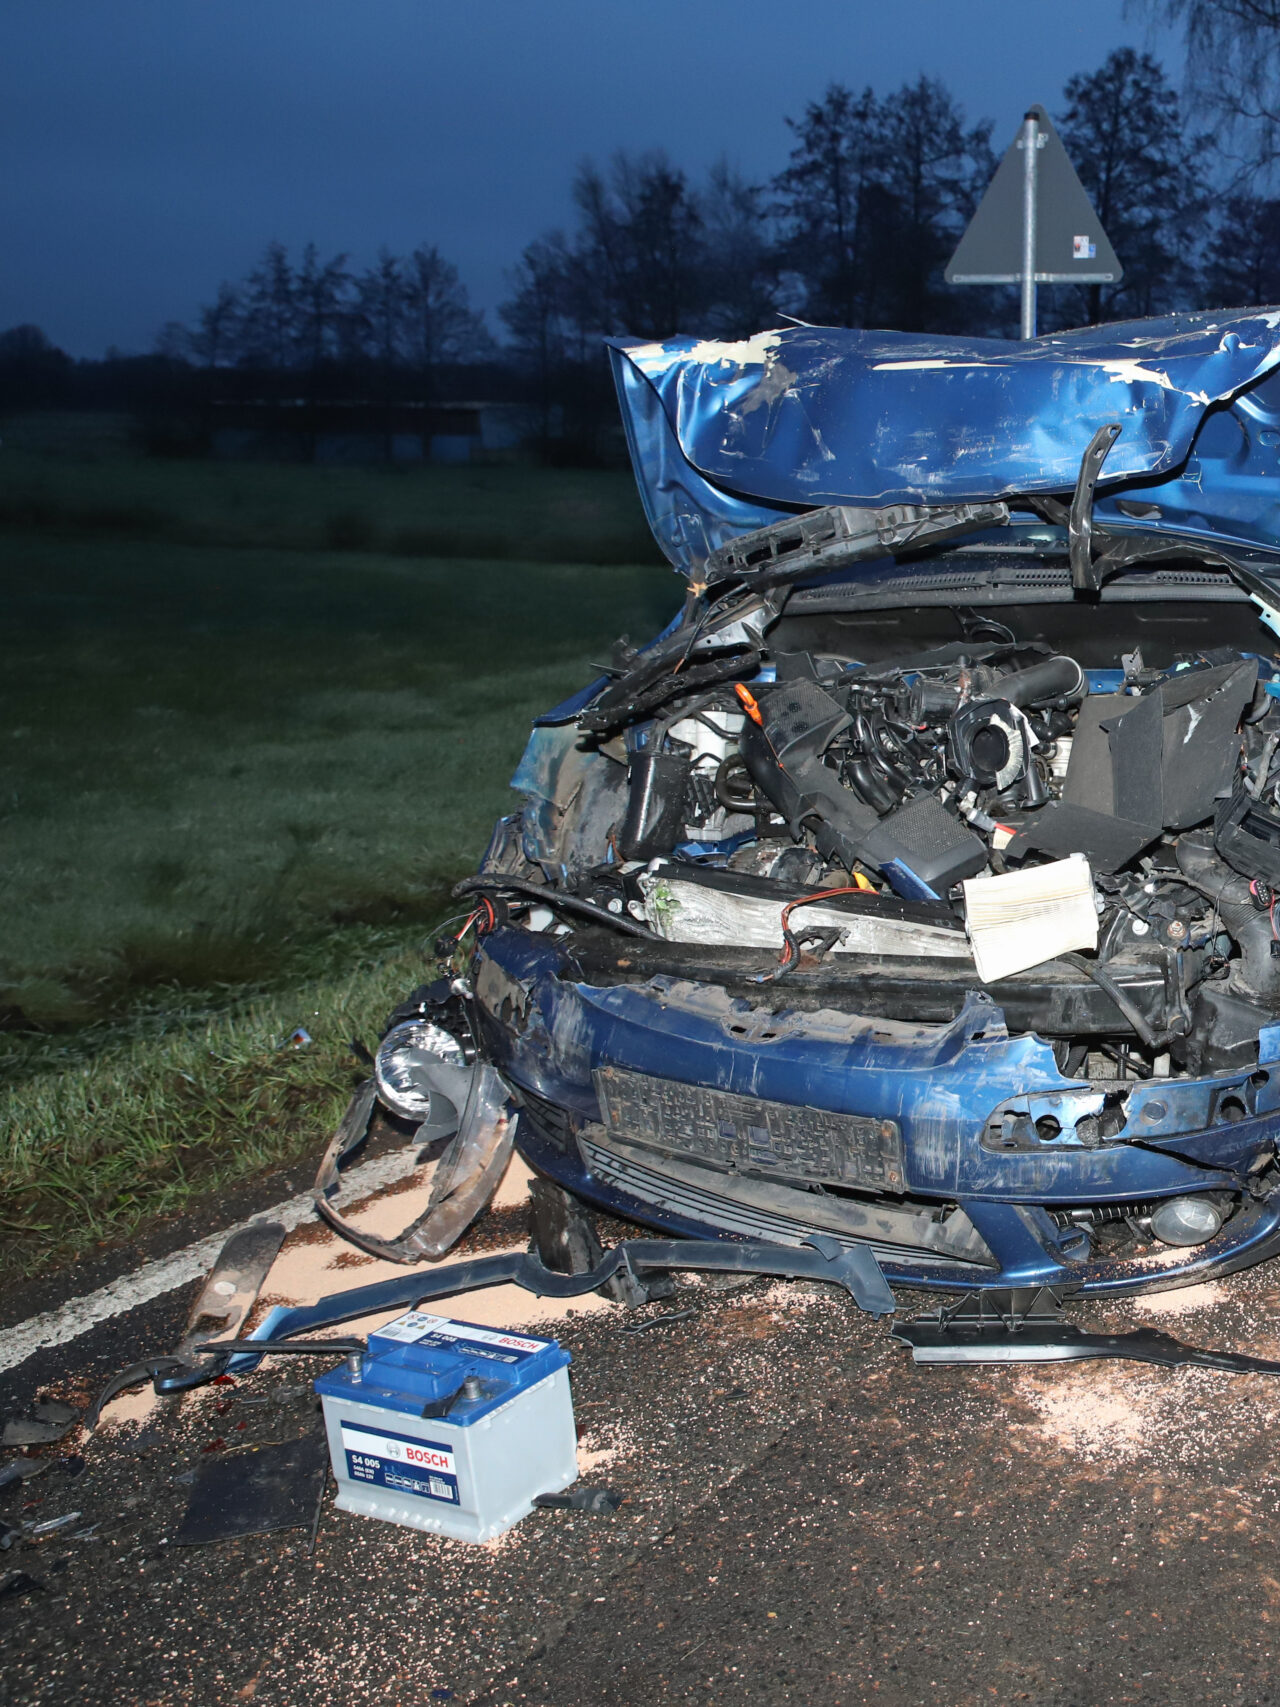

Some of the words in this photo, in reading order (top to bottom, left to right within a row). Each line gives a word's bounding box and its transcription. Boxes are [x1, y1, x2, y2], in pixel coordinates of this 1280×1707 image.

[498, 1336, 539, 1350] BOSCH
[352, 1454, 363, 1465] S4
[364, 1457, 381, 1469] 005
[406, 1447, 449, 1468] BOSCH
